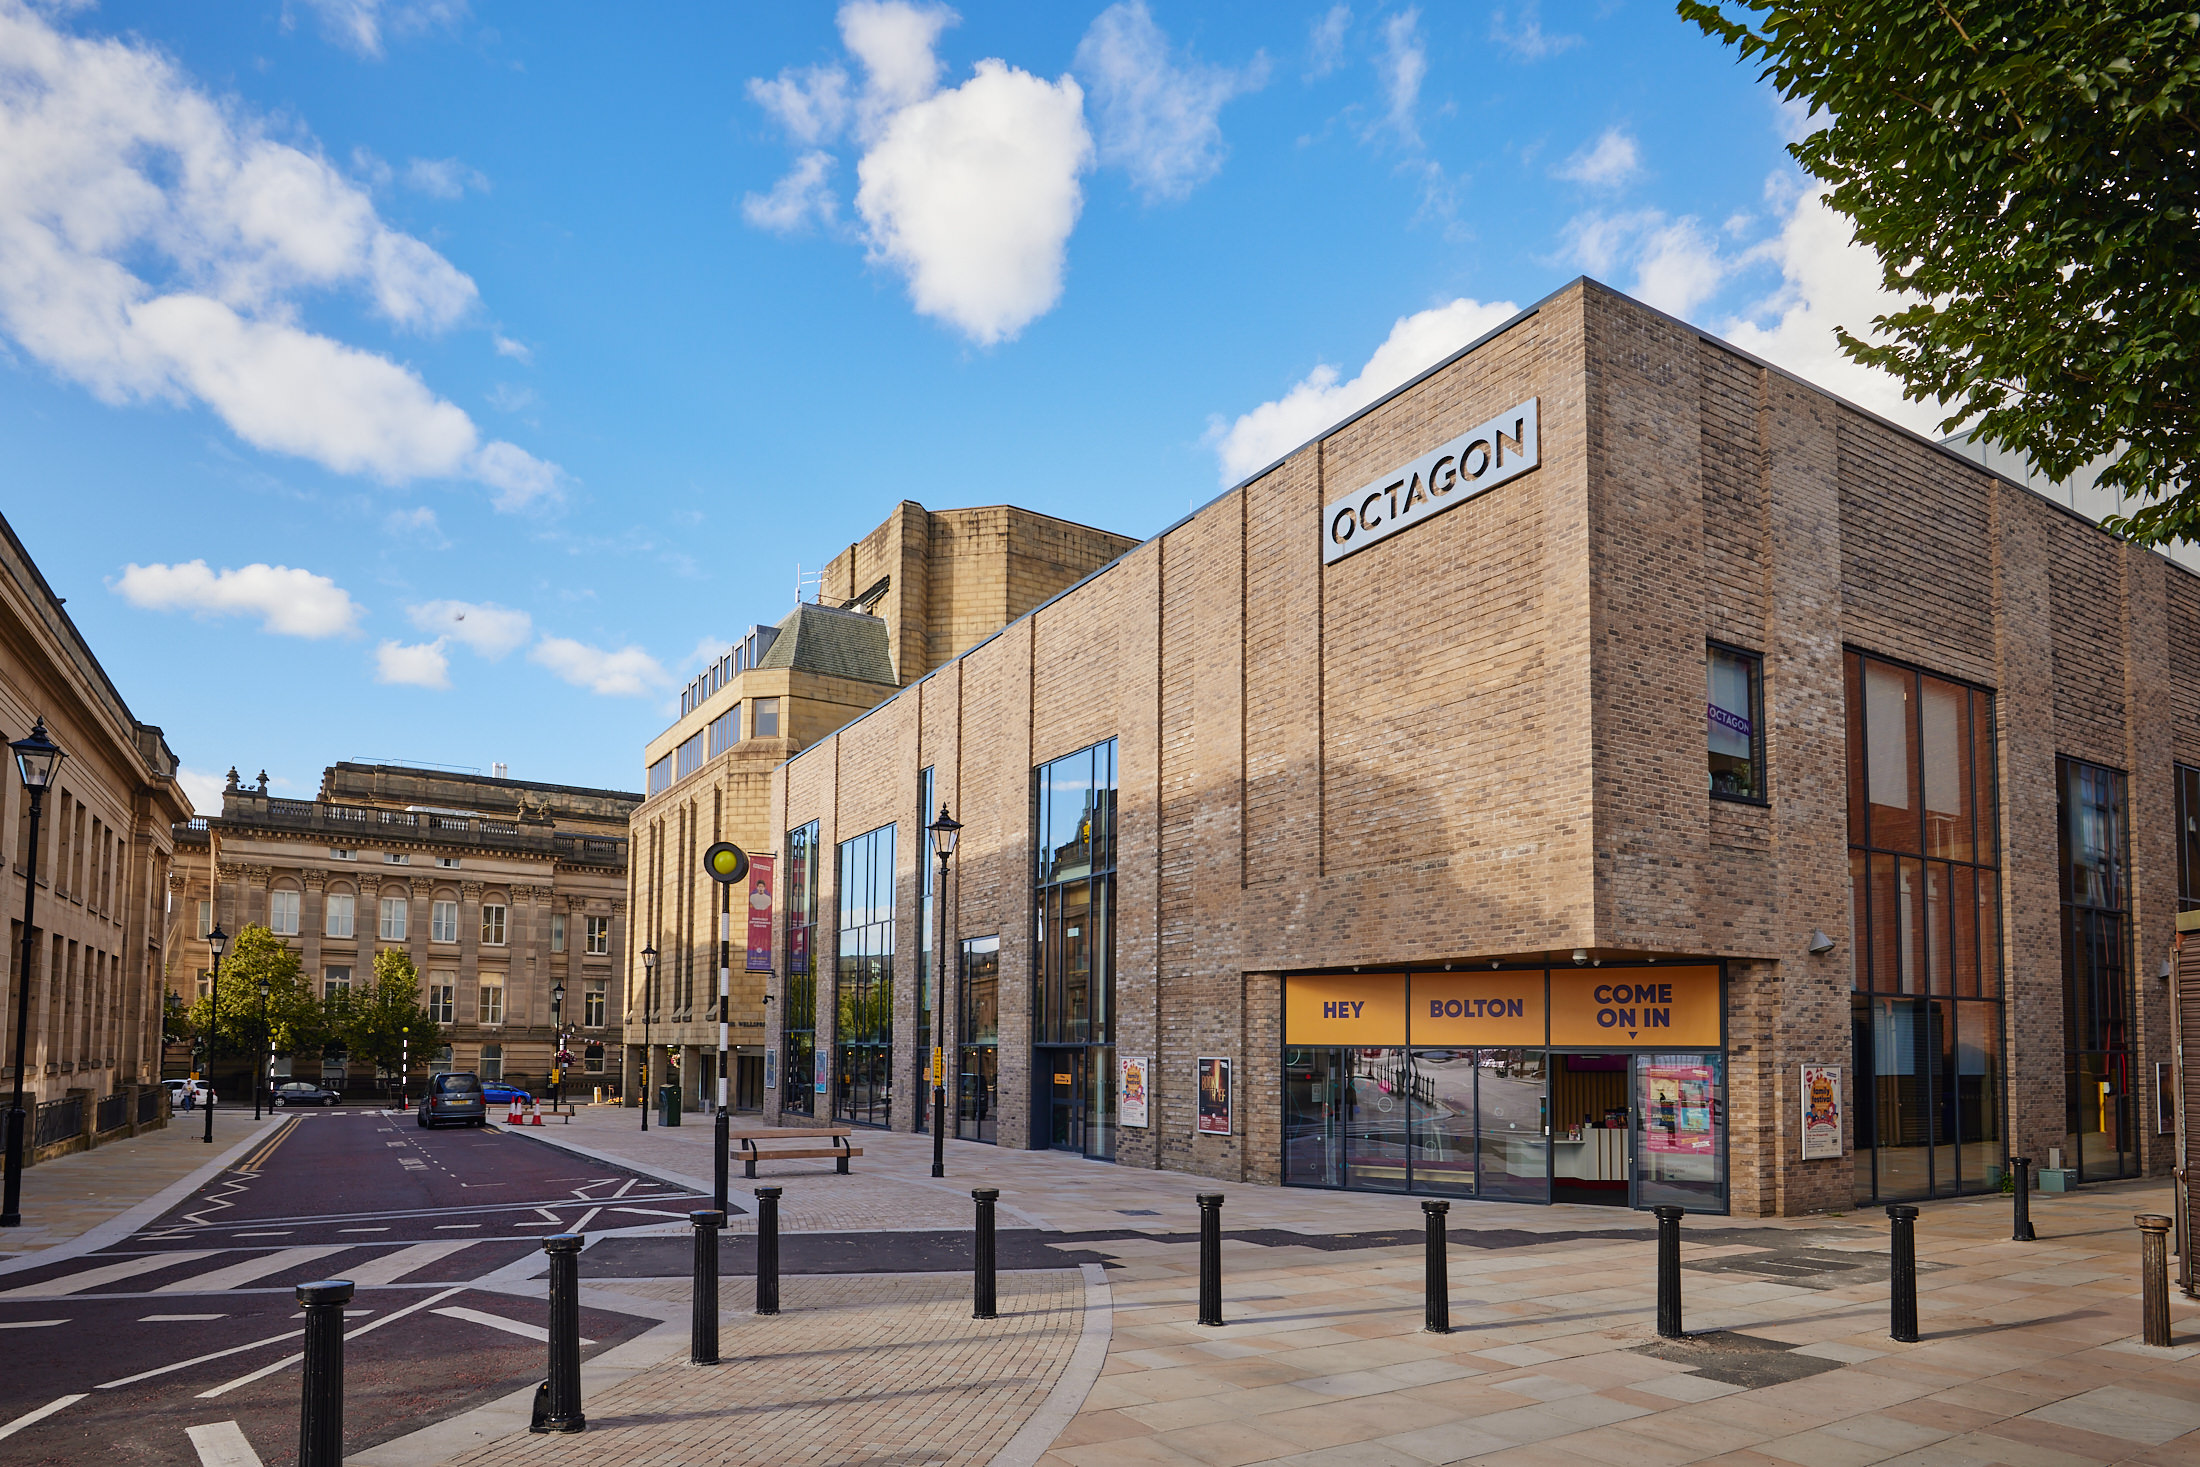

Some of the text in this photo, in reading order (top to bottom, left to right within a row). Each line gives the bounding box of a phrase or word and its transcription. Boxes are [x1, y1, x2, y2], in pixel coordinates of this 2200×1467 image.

[1332, 417, 1524, 545] OCTAGON
[1709, 707, 1749, 732] OCTAGON
[1594, 983, 1673, 1004] COME
[1323, 1001, 1365, 1019] HEY
[1430, 998, 1523, 1018] BOLTON
[1596, 1007, 1670, 1028] ON IN
[1811, 1095, 1832, 1103] festival
[1813, 1087, 1830, 1096] family
